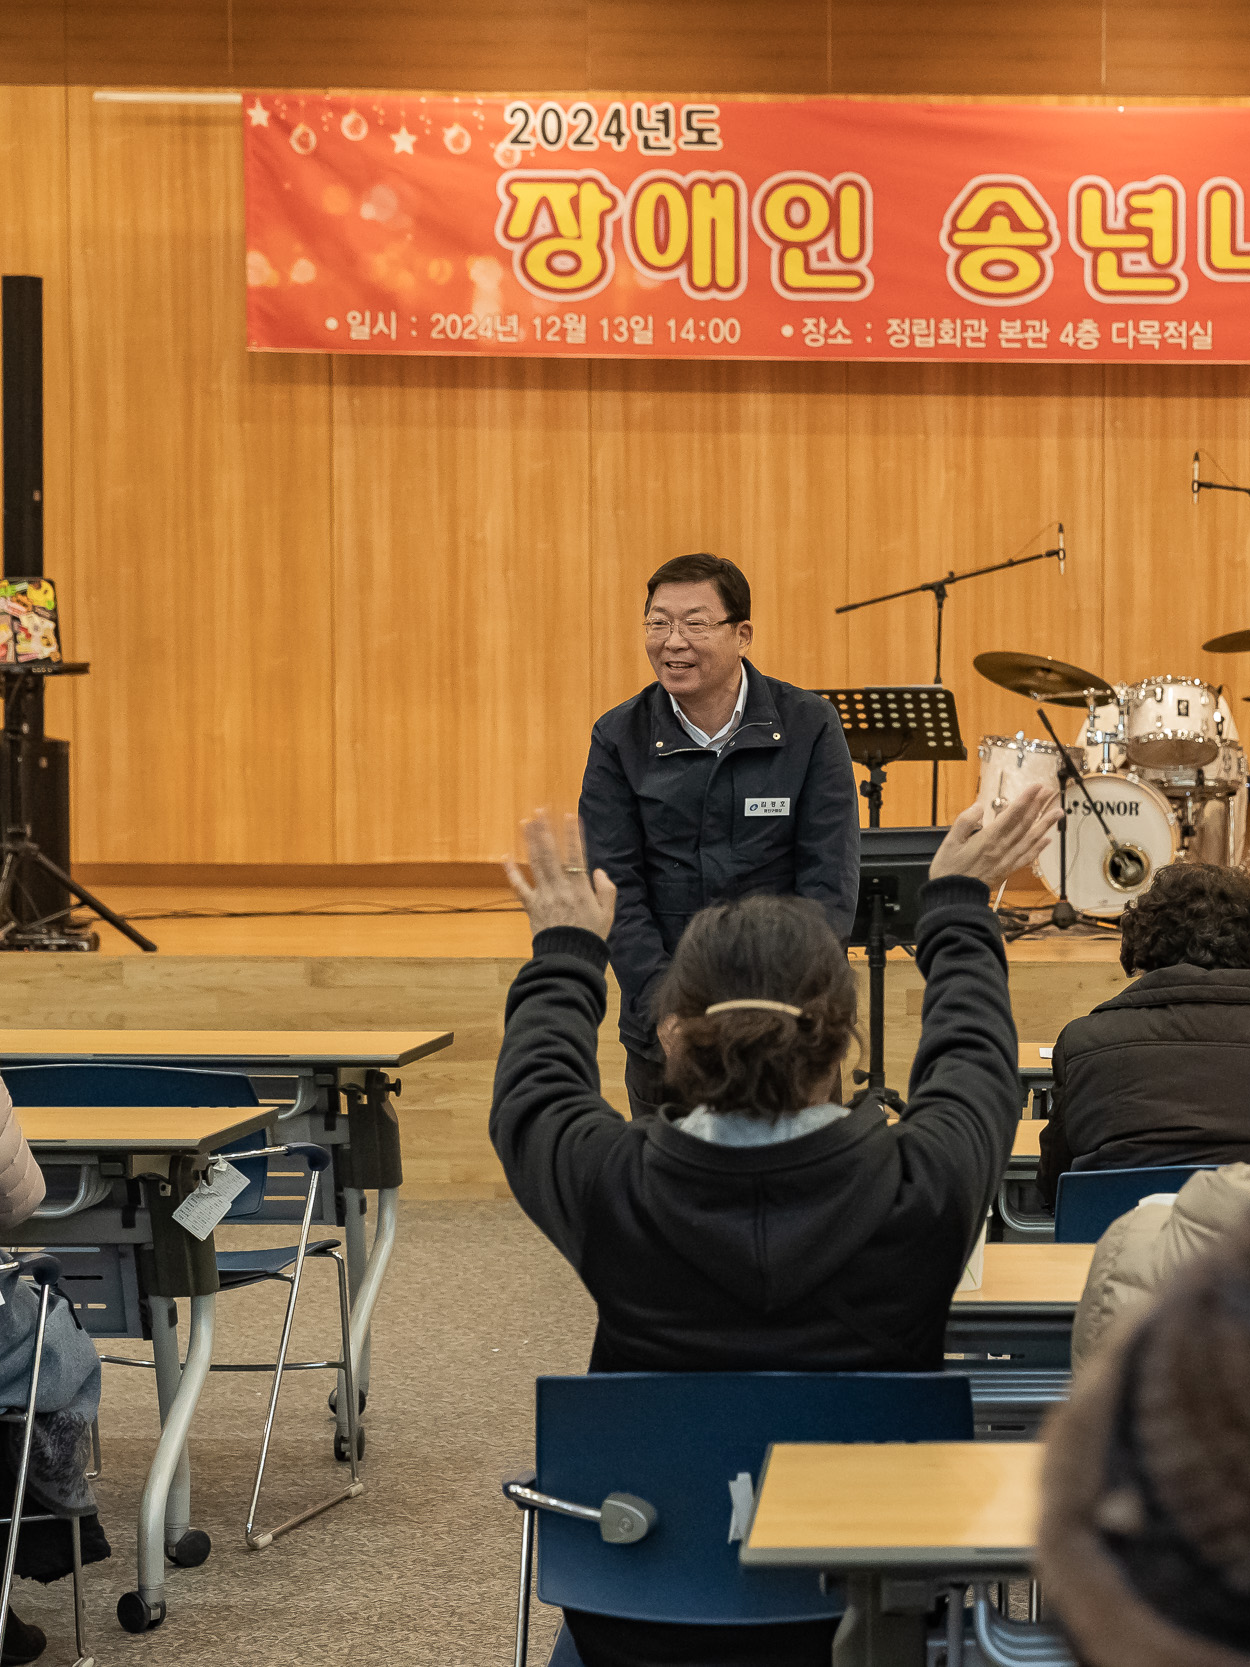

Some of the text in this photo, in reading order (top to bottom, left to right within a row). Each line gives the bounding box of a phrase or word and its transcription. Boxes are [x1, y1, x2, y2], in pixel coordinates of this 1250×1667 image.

[504, 103, 721, 153] 2024년도
[498, 170, 872, 300] 장애인
[346, 311, 397, 340] 일시
[430, 312, 519, 342] 2024년
[533, 314, 586, 344] 12월
[600, 316, 654, 345] 13일
[667, 317, 741, 344] 14:00
[802, 317, 853, 347] 장소
[886, 318, 989, 348] 정립회관
[998, 319, 1050, 349] 본관
[1059, 319, 1101, 350] 4층
[1111, 320, 1213, 350] 다목적실
[1082, 801, 1139, 816] SONOR
